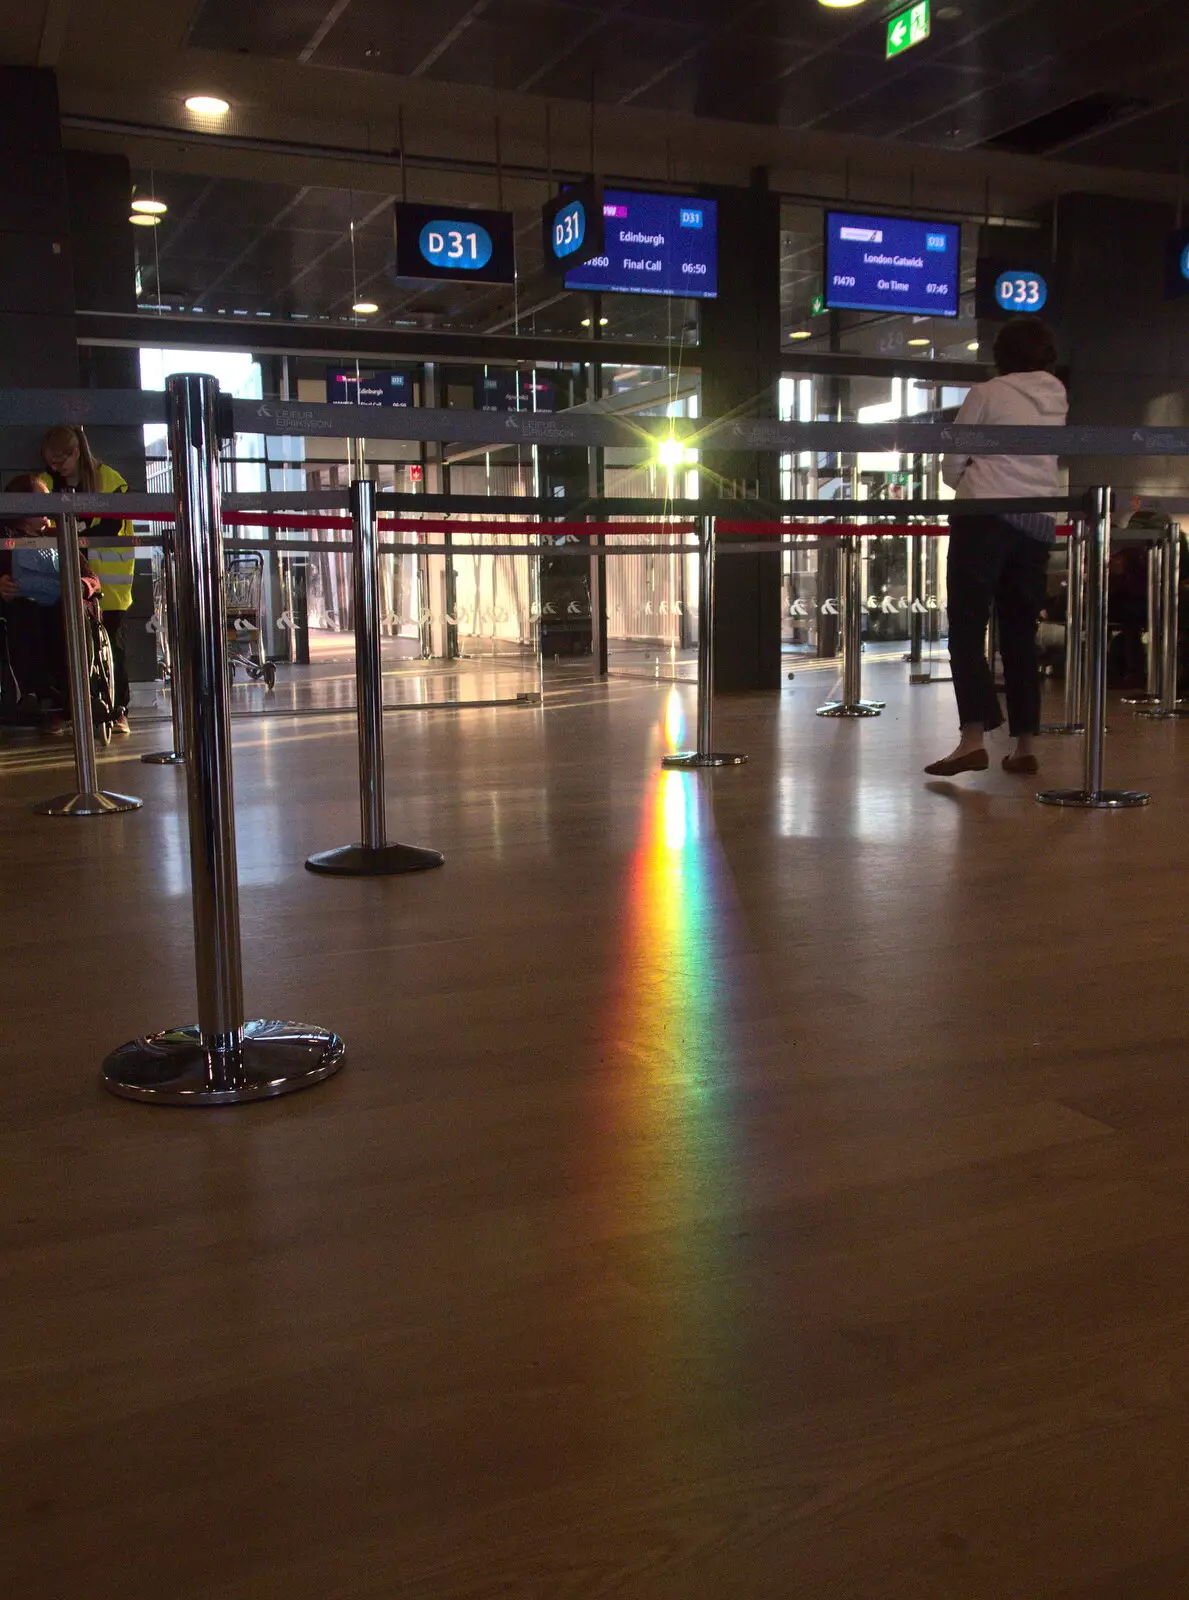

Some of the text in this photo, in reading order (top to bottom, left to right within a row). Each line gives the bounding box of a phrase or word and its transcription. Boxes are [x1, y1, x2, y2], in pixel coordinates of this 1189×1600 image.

[682, 212, 700, 224] D31
[556, 211, 579, 246] D31
[428, 231, 478, 260] D31
[619, 231, 665, 247] Edinburgh
[623, 259, 662, 271] Final Call
[863, 253, 923, 268] London Gatwick
[681, 263, 707, 275] 06:50
[877, 279, 909, 292] On Time
[1001, 279, 1039, 304] D33
[359, 387, 383, 397] dinburgh
